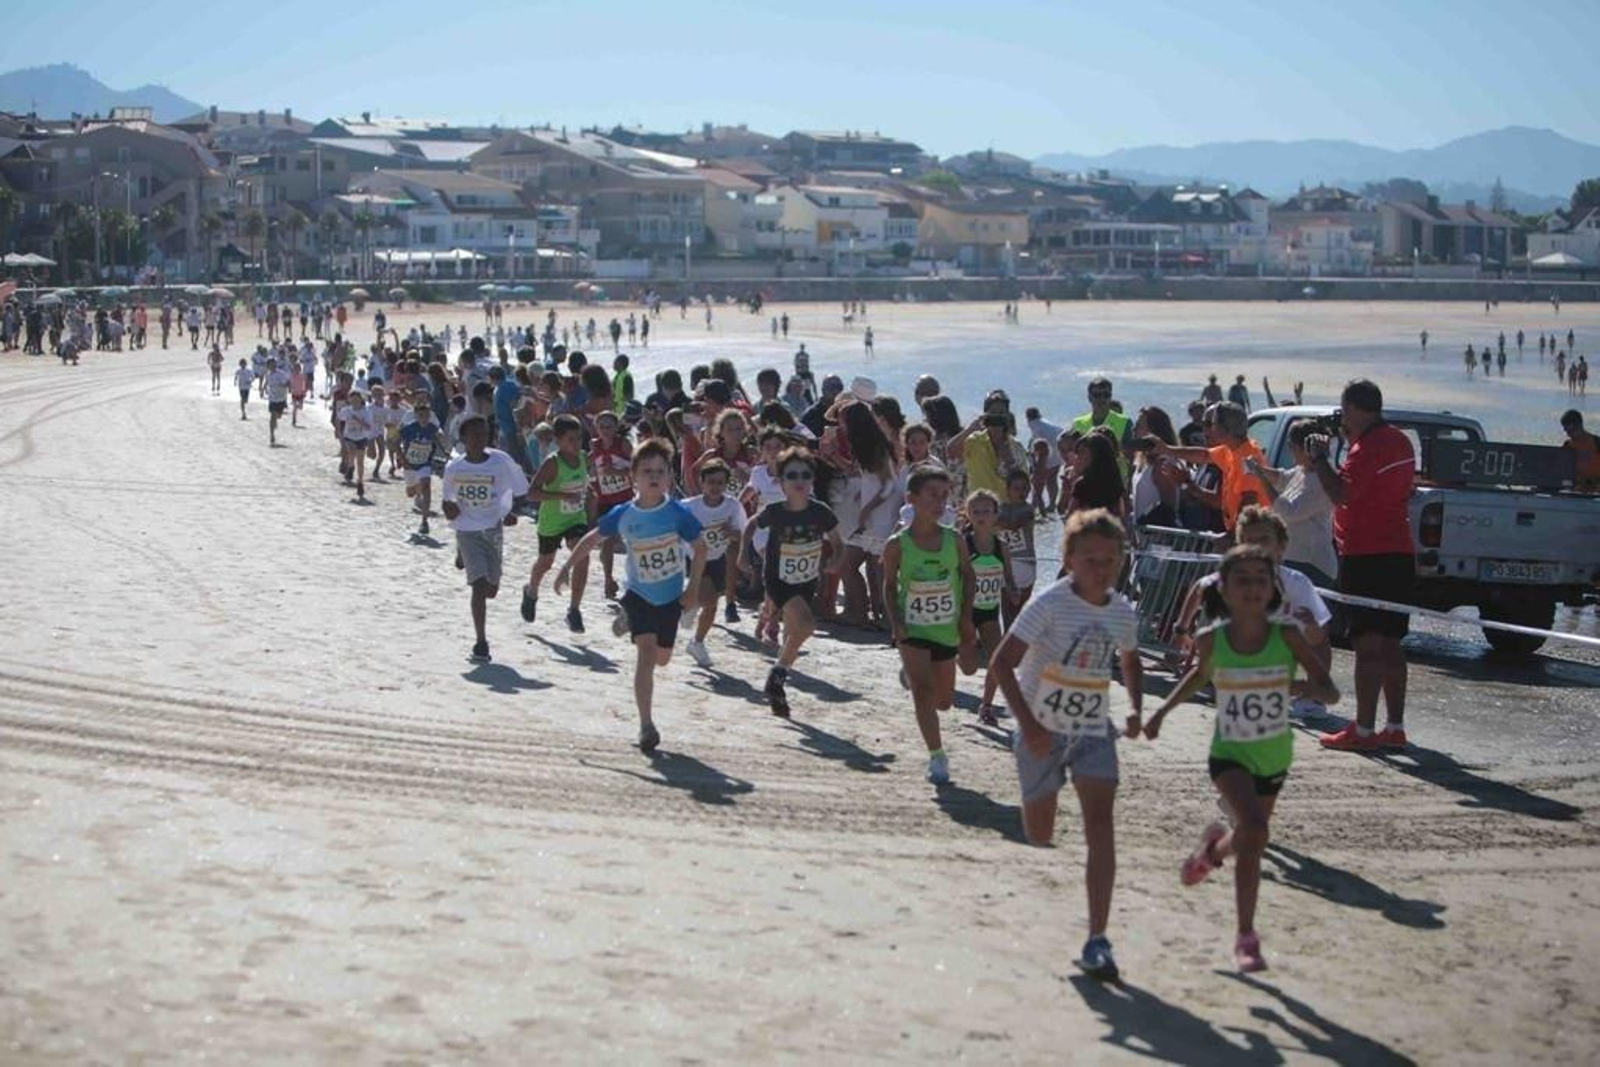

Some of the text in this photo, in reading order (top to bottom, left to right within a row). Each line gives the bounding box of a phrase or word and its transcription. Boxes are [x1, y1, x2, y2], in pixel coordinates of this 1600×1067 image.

[457, 485, 488, 500] 488
[639, 552, 677, 570] 484
[785, 556, 819, 574] 507
[910, 595, 954, 615] 455
[1044, 689, 1103, 719] 482
[1225, 691, 1284, 722] 463
